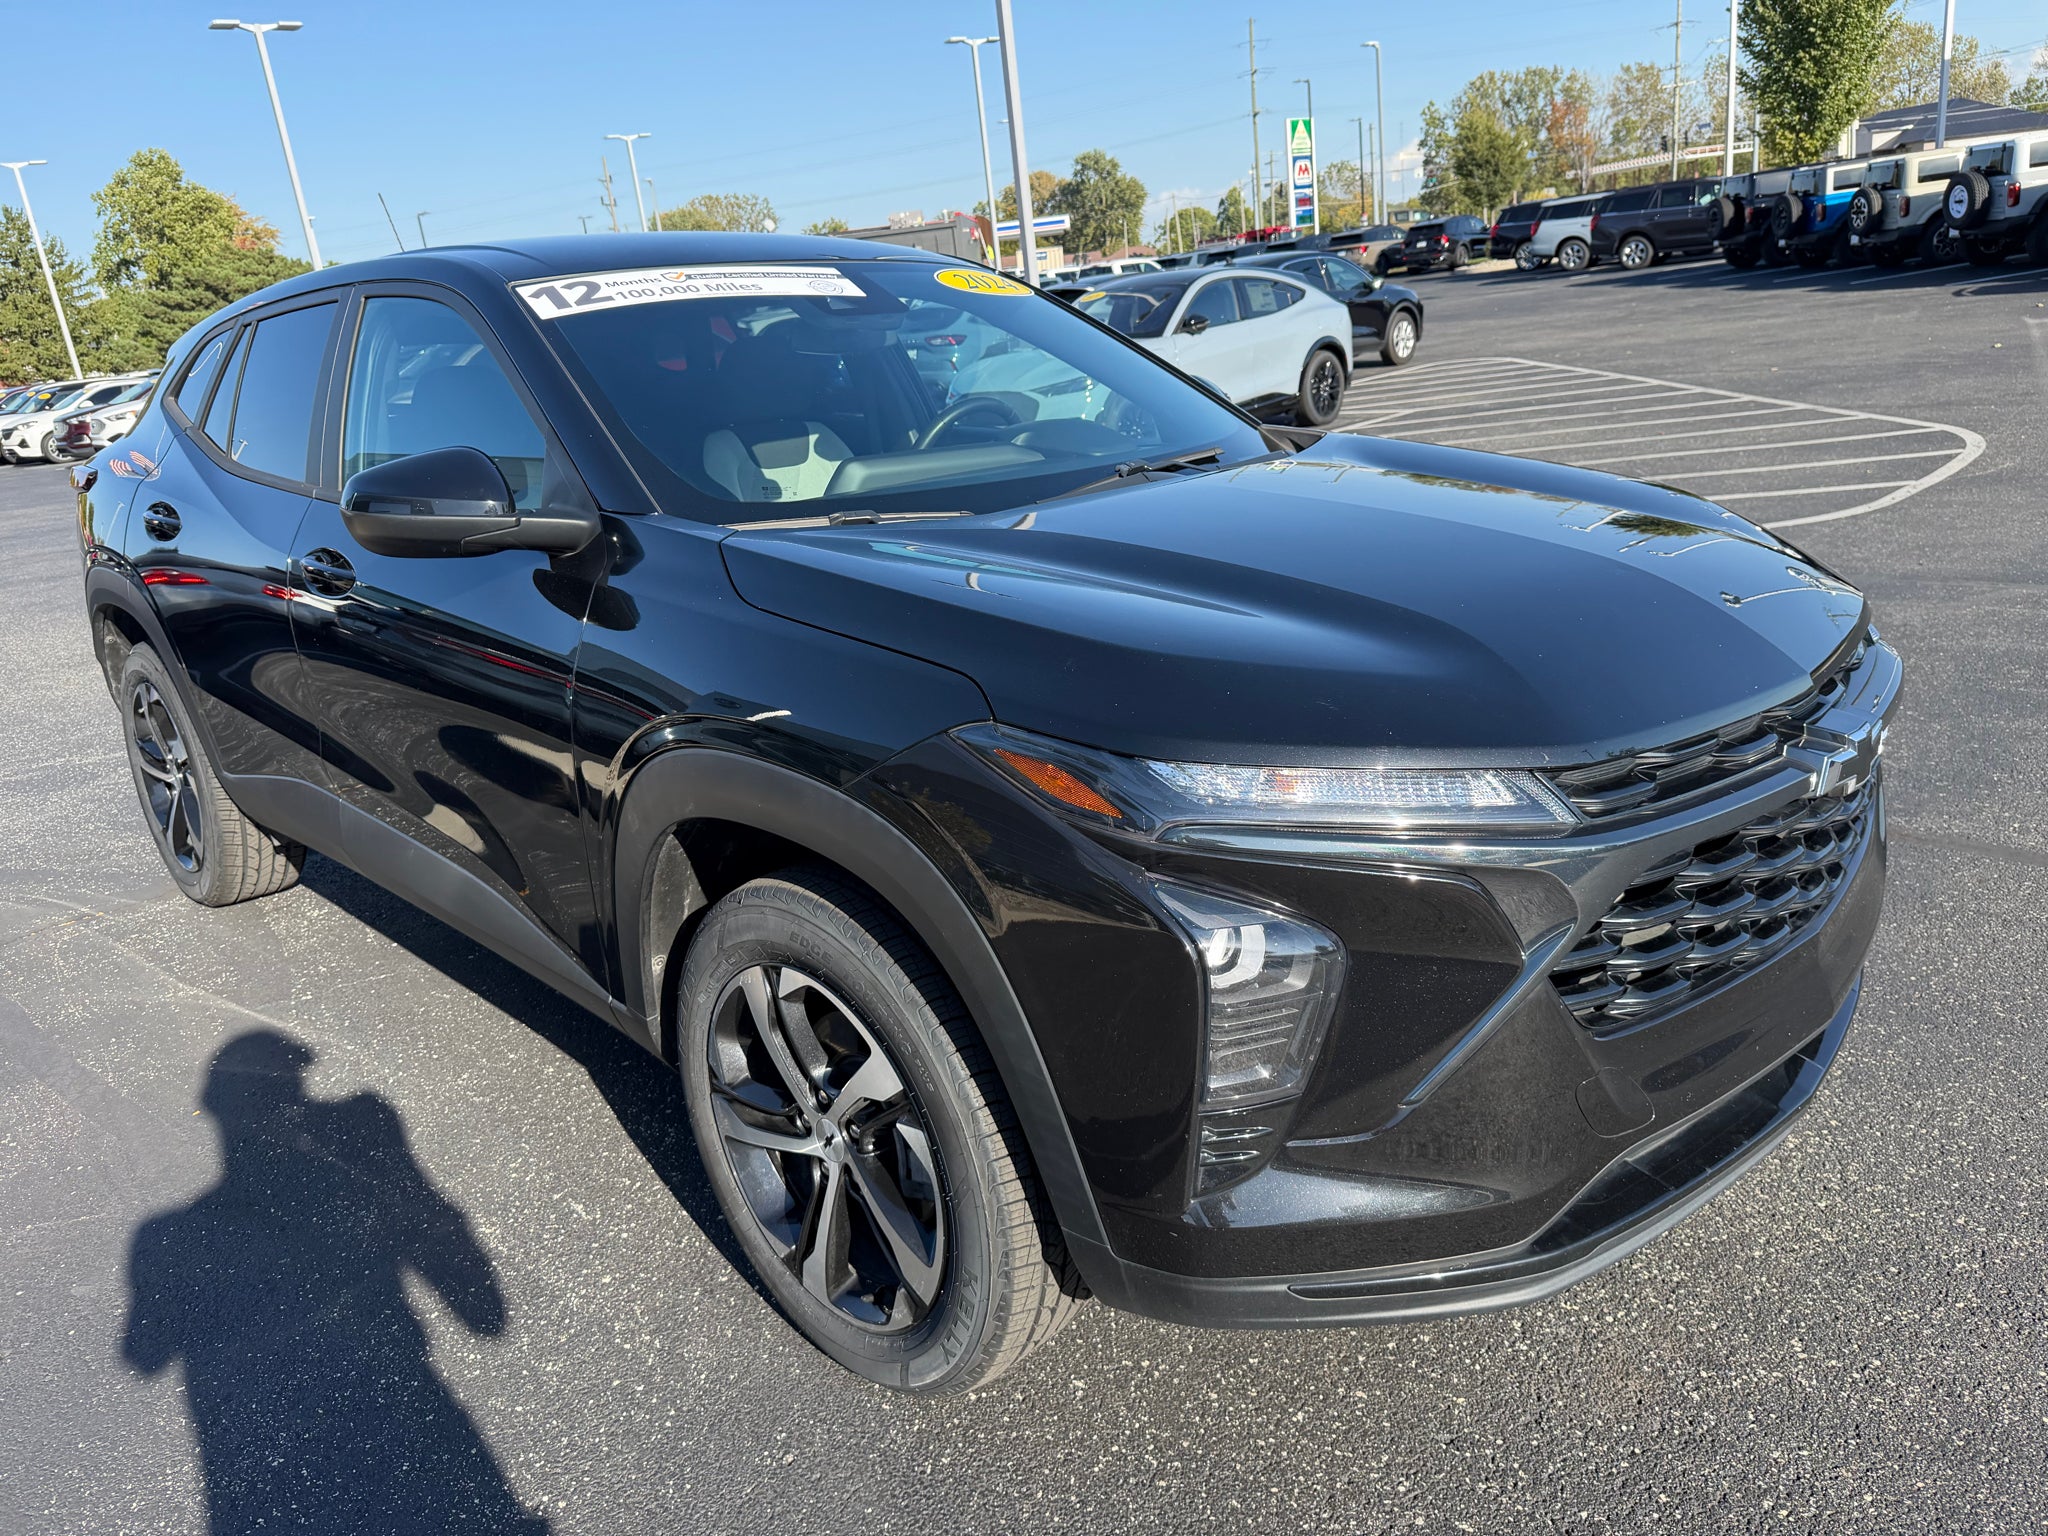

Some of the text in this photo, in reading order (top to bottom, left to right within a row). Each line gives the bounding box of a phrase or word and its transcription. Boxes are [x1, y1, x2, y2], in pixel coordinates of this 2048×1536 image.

[604, 277, 662, 288] Months
[616, 284, 700, 300] 100,000
[704, 282, 763, 292] Miles
[953, 274, 1019, 291] 2024
[528, 280, 616, 311] 12
[788, 931, 834, 965] EDGE
[940, 1264, 979, 1366] KELLY
